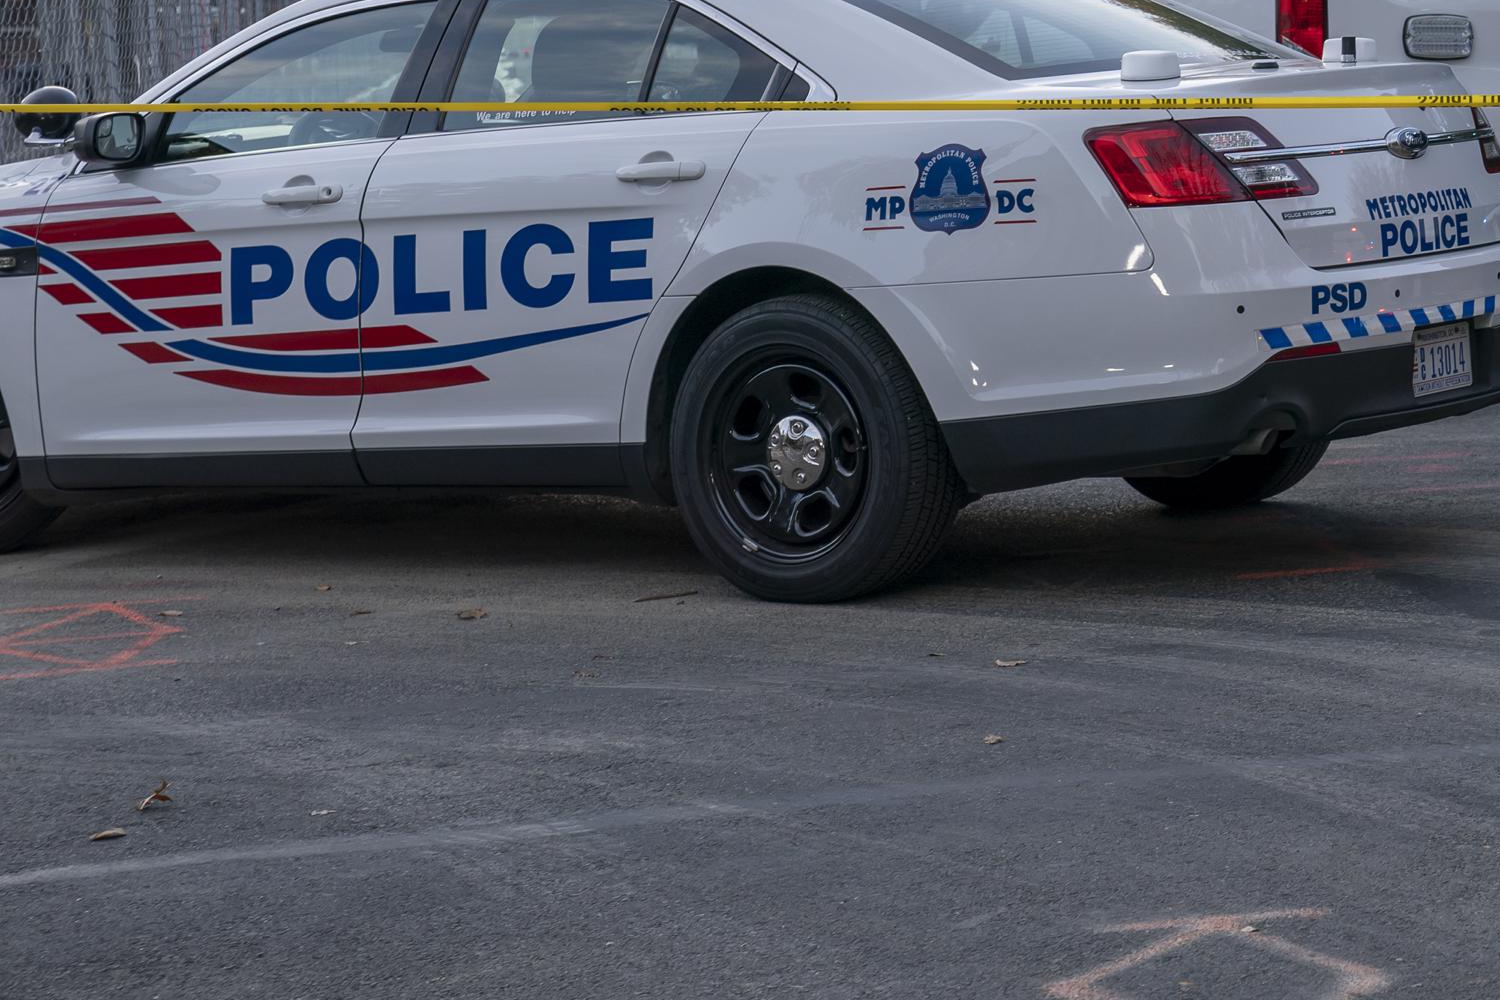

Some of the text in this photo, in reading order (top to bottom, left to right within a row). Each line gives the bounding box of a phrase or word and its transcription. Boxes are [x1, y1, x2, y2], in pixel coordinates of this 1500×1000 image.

[476, 111, 491, 121] We
[494, 111, 510, 120] are
[919, 149, 979, 188] METROPOLITAN POLICE
[864, 195, 906, 222] MP
[928, 213, 970, 223] WASHINGTON
[995, 188, 1035, 214] DC
[1366, 187, 1472, 221] METROPOLITAN
[1380, 213, 1471, 258] POLICE
[231, 217, 655, 326] POLICE
[1311, 281, 1367, 315] PSD
[1430, 341, 1466, 379] 13014
